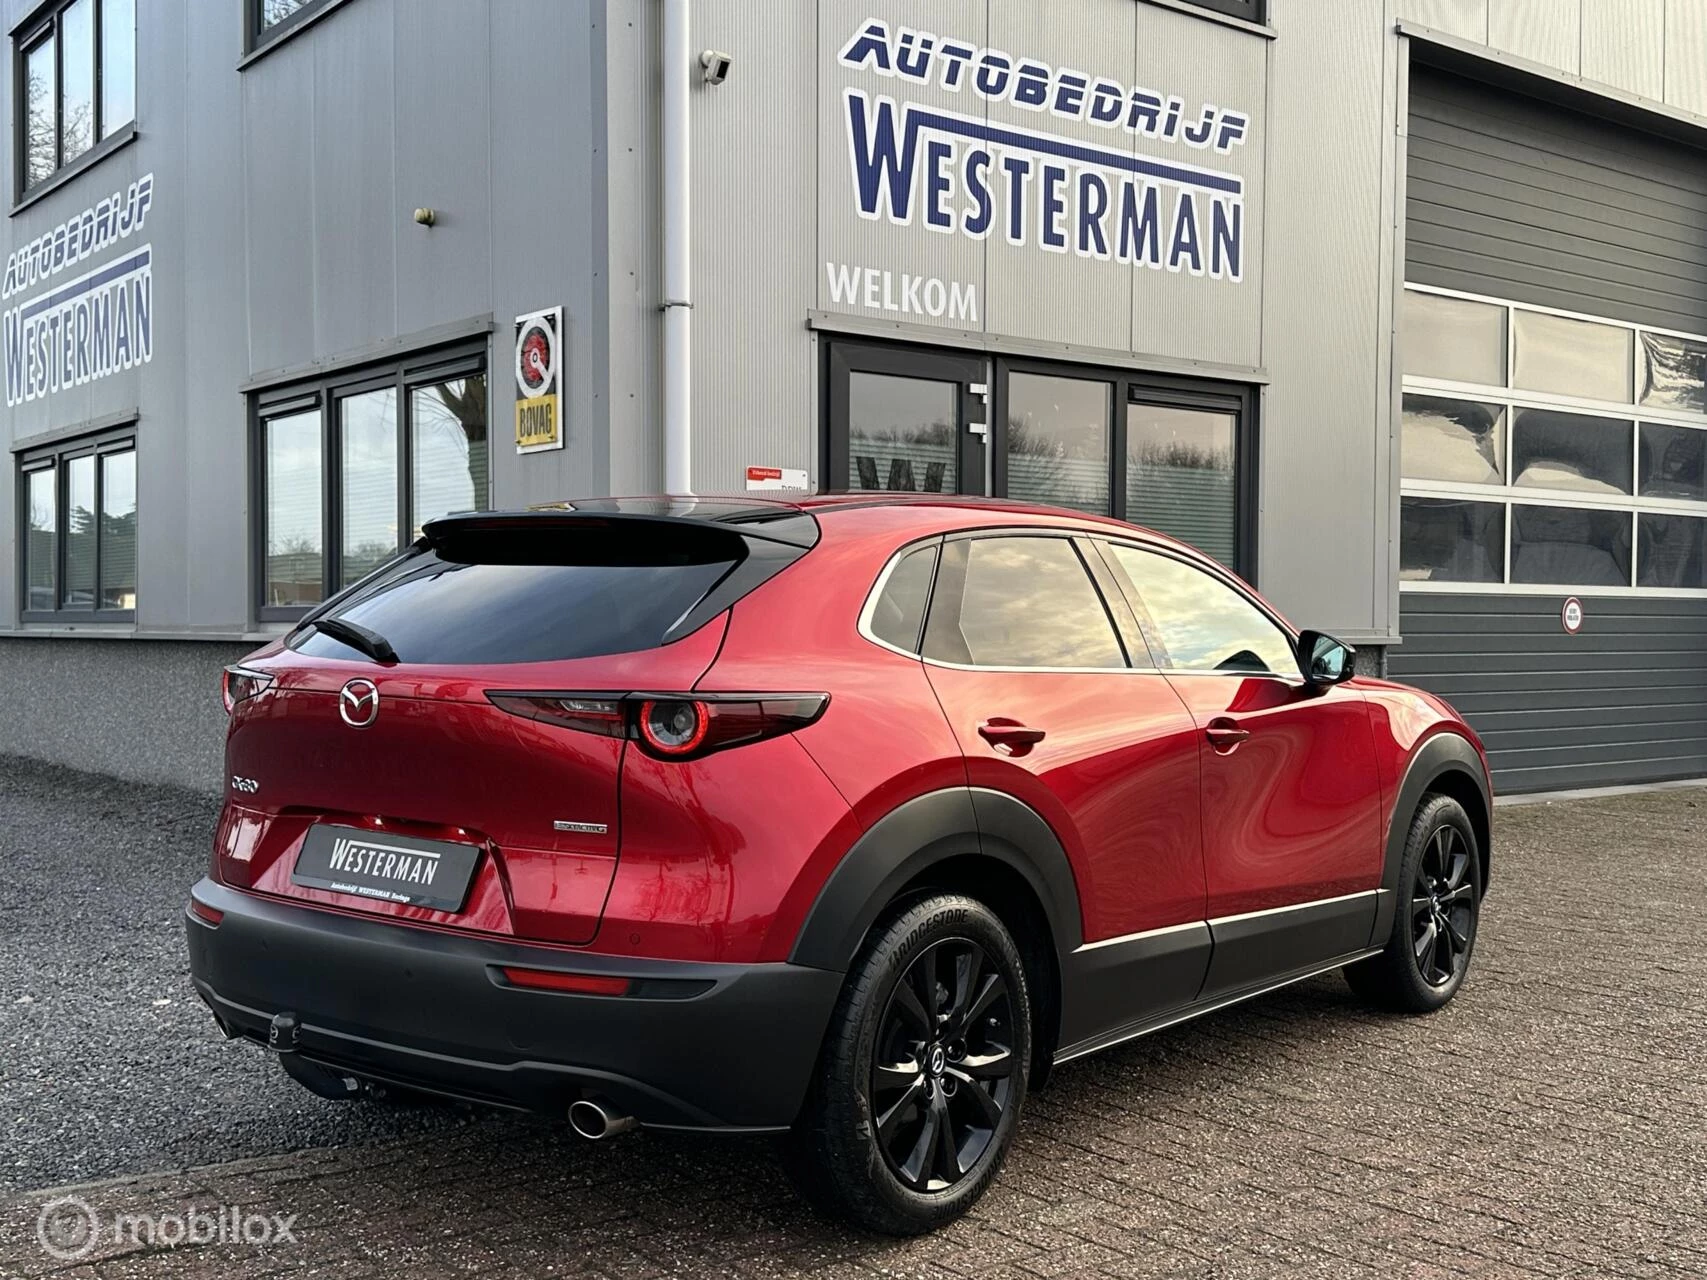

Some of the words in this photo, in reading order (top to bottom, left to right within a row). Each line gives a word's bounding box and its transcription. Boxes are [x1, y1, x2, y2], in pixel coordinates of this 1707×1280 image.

[845, 91, 1243, 280] WESTERMAN
[3, 176, 152, 297] AUTOBEDRIJF
[826, 262, 978, 321] WELKOM
[4, 250, 152, 405] WESTERMAN
[519, 403, 552, 437] BOVAG
[329, 838, 441, 885] WESTERMAN
[888, 908, 969, 971] BRIDGESTONE
